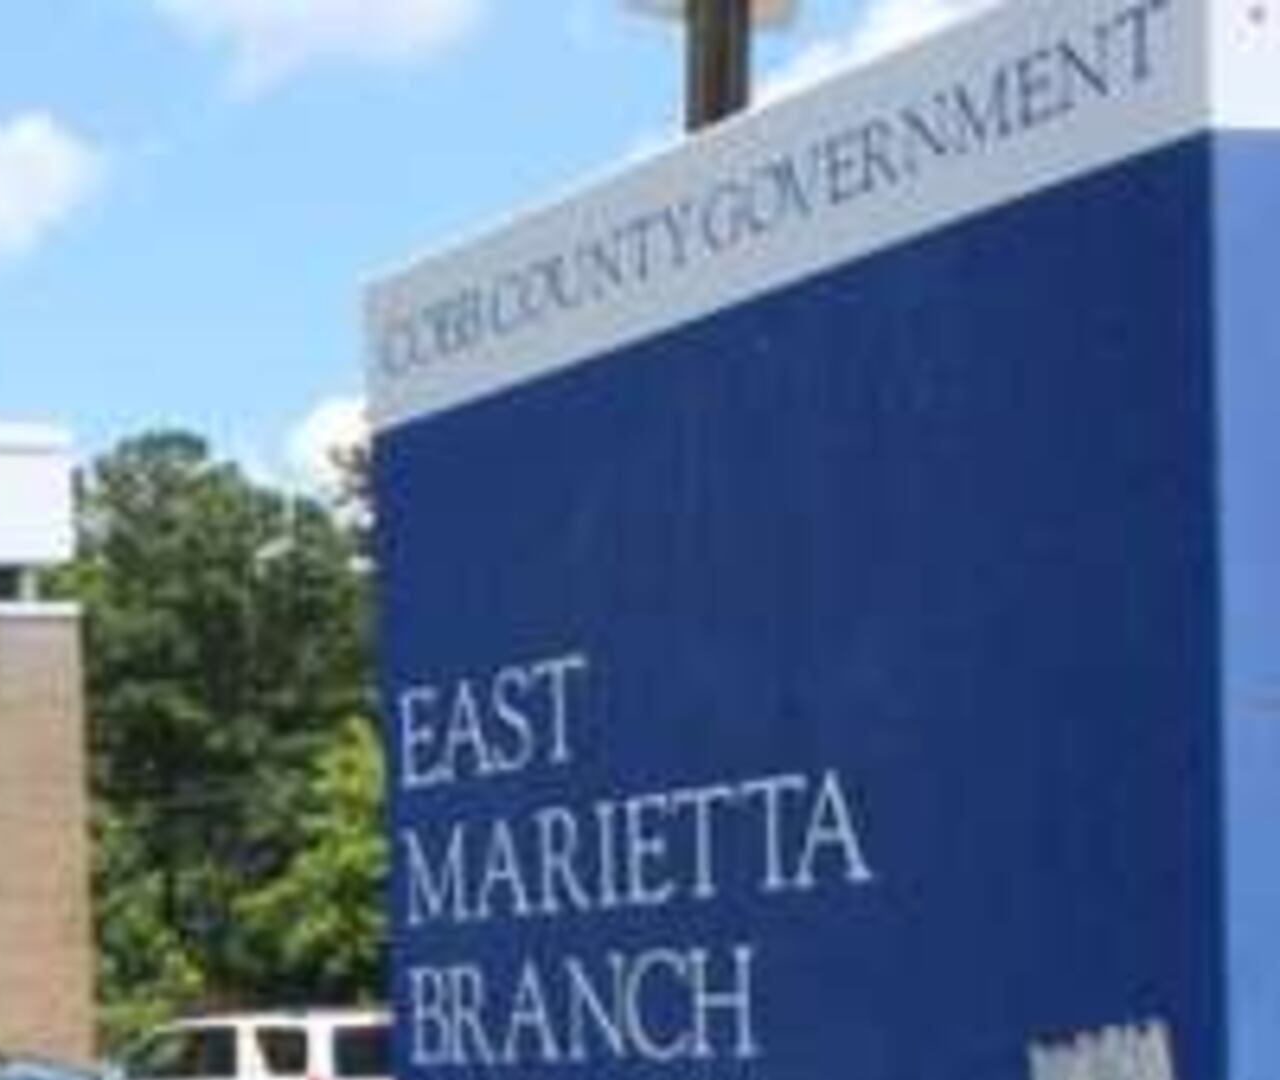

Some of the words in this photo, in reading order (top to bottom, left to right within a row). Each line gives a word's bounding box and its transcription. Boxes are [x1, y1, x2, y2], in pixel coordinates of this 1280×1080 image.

[491, 204, 697, 334] COUNTY
[698, 0, 1172, 252] GOVERNMENT
[399, 655, 586, 790] EAST
[403, 768, 874, 926] MARIETTA
[409, 946, 760, 1067] BRANCH
